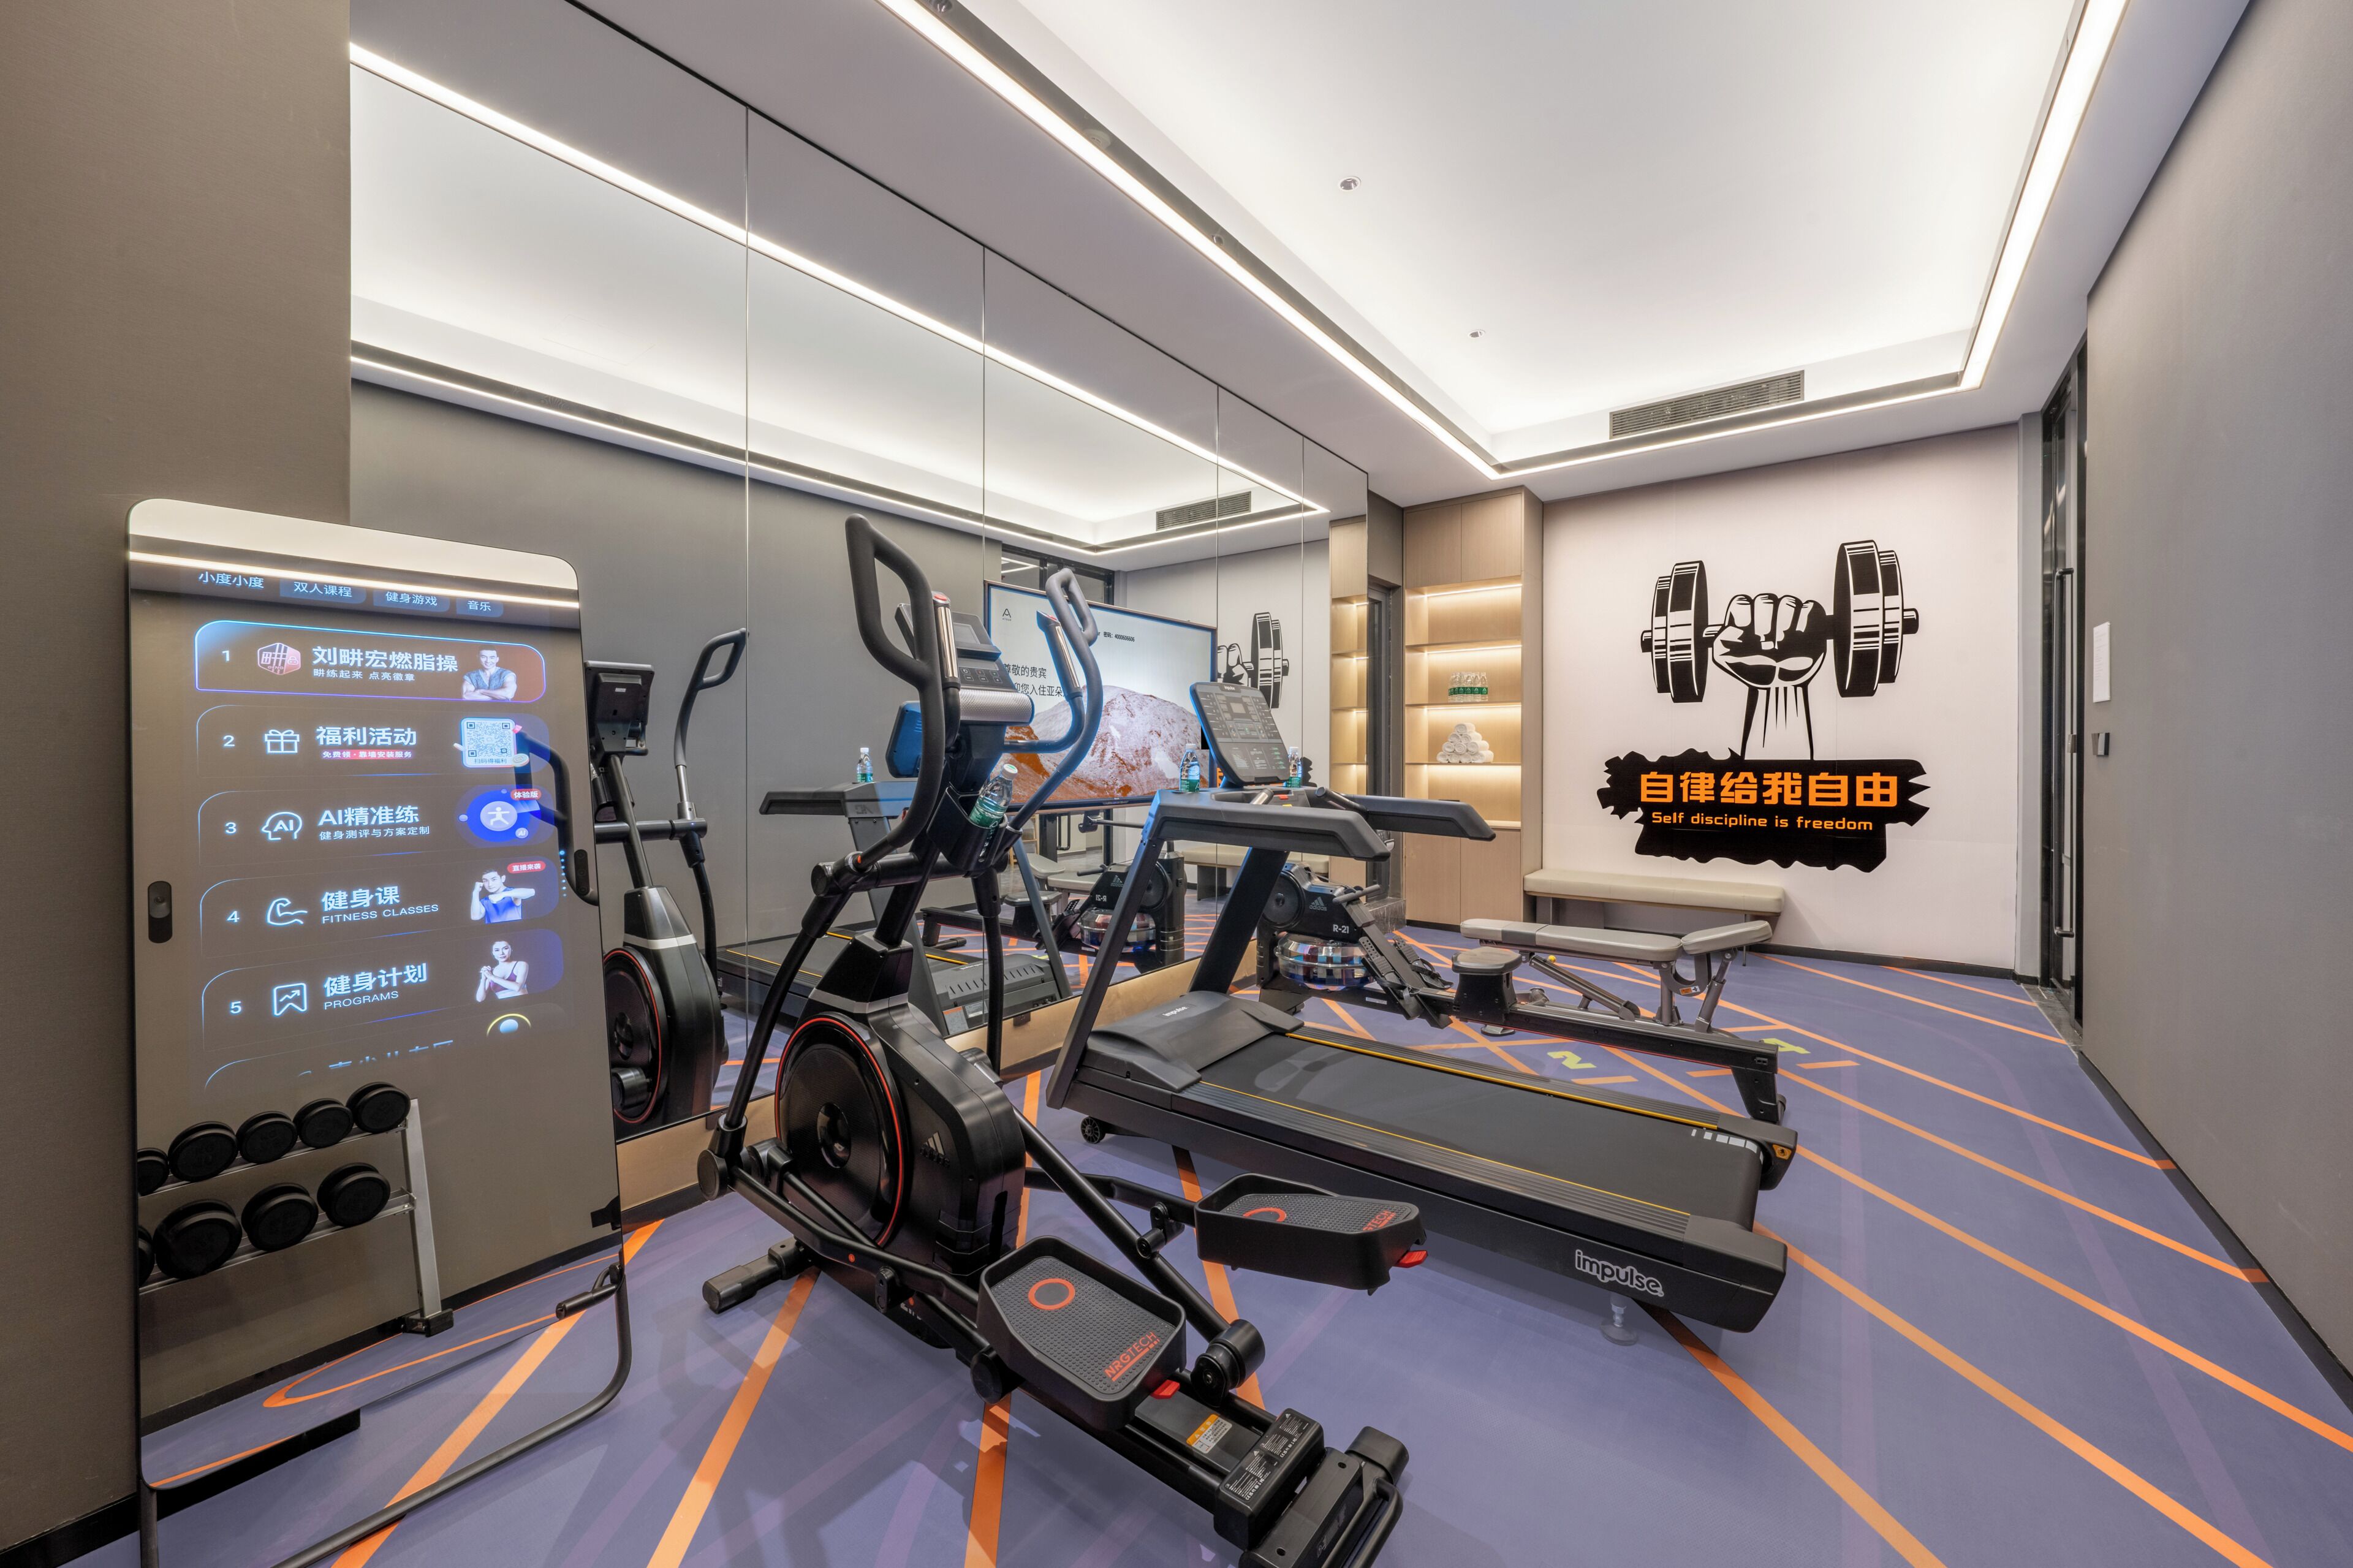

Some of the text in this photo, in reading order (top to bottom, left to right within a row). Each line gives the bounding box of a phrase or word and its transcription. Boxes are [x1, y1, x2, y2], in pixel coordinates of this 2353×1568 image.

[199, 571, 264, 589] 小度小度
[294, 581, 352, 598] 双人课程
[385, 591, 438, 607] 健身游戏
[468, 600, 491, 612] 音乐
[222, 650, 230, 662] 1
[312, 646, 459, 673] 刘畊宏燃脂操
[313, 668, 415, 681] 畊练起来 点亮徽章
[1015, 682, 1064, 697] 您入住亚朵
[223, 735, 235, 747] 2
[316, 726, 417, 746] 福利活动
[1640, 771, 1898, 808] 自律给我自由
[318, 805, 420, 827] AI精准练
[1652, 811, 1873, 831] Self discipline is freedom
[225, 822, 237, 834] 3
[274, 820, 294, 831] AI
[319, 825, 430, 841] 健身测评与方案定制
[512, 863, 541, 872] 直播来袭
[321, 885, 401, 912] 健身课
[227, 911, 240, 923] 4
[322, 904, 439, 924] FITNESS CLASSES
[1333, 923, 1349, 934] R-21
[324, 962, 428, 998] 健身计划
[230, 1001, 242, 1015] 5
[324, 990, 400, 1010] PROGRAMS
[1547, 1051, 1597, 1069] 2
[1363, 1210, 1393, 1231] GTECH
[1575, 1249, 1664, 1297] impulse
[1104, 1331, 1157, 1378] NRGTECH
